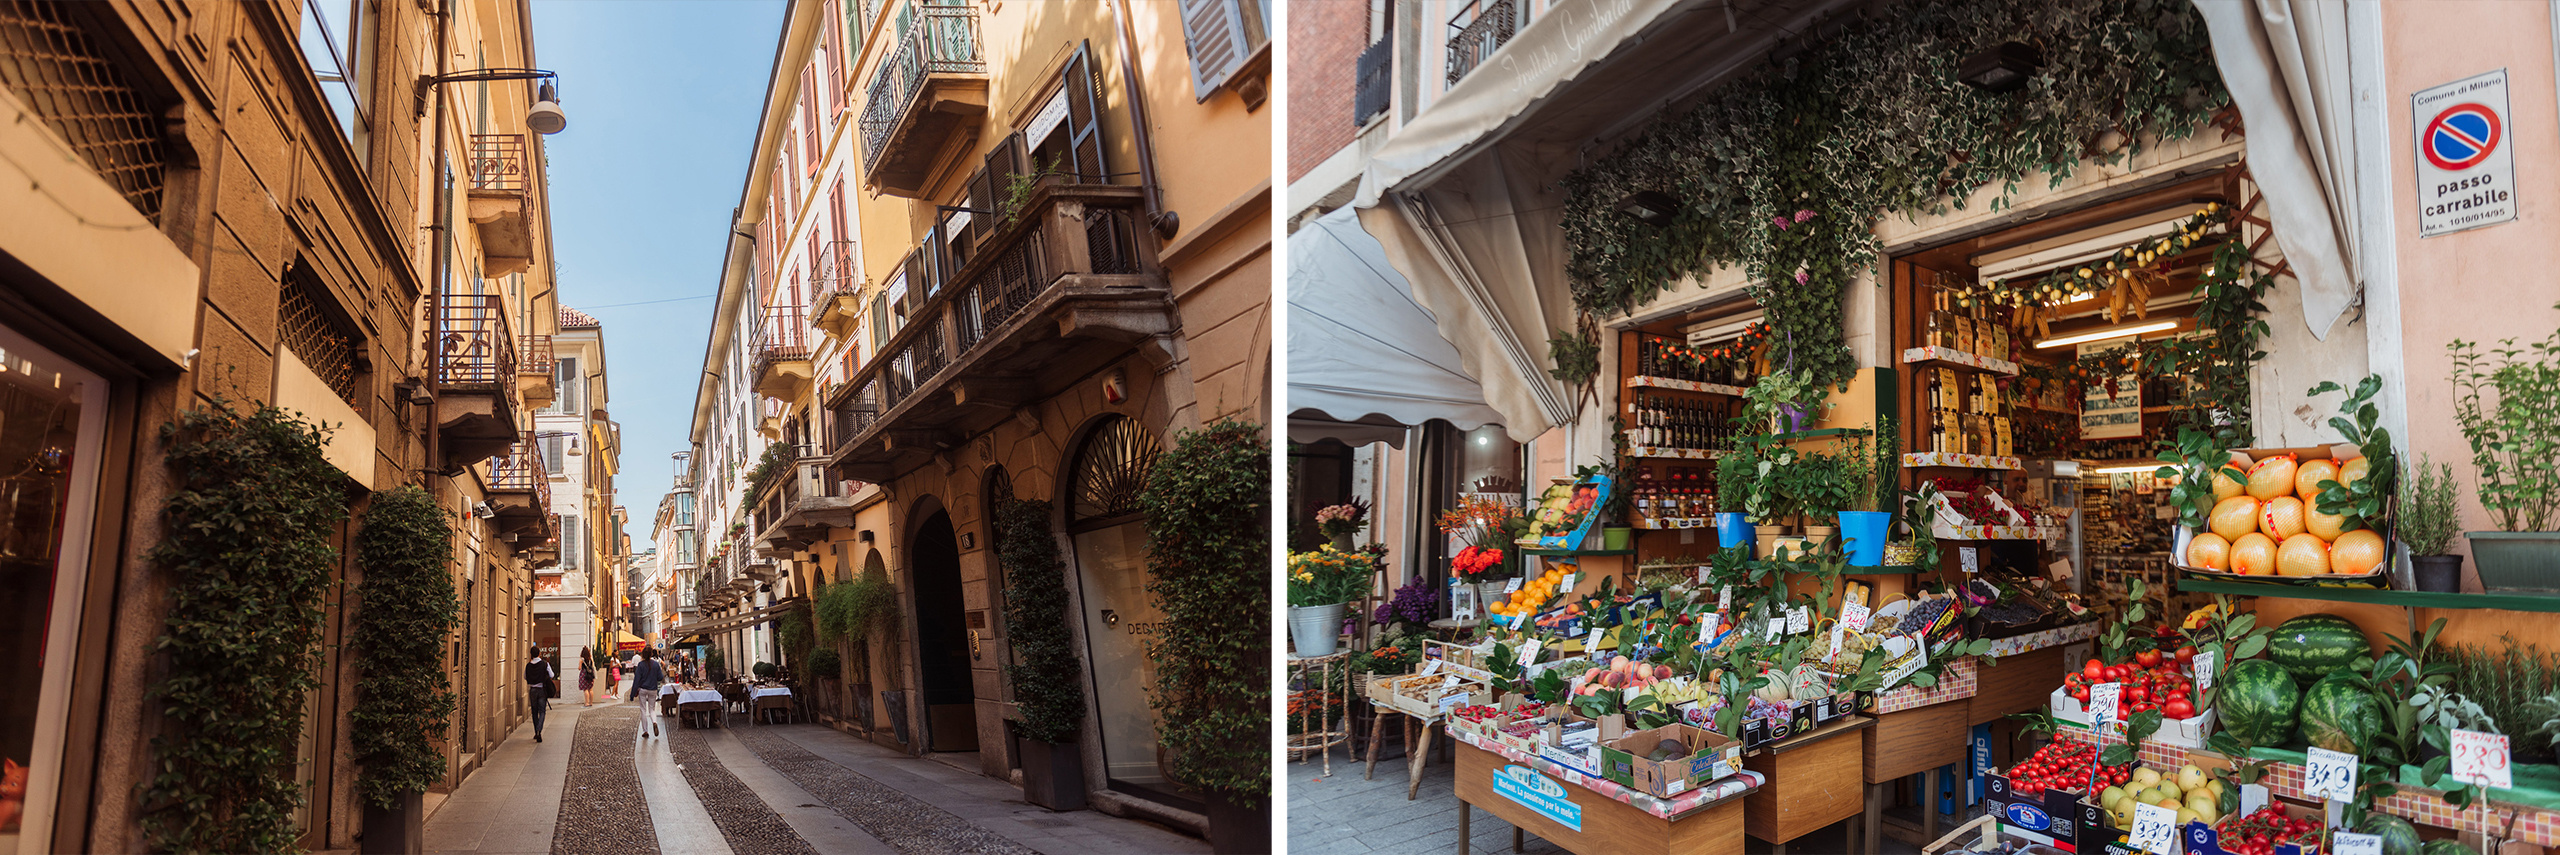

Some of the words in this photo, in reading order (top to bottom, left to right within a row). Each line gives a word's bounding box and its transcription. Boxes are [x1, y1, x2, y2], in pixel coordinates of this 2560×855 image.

[2418, 91, 2455, 105] Comune
[2458, 85, 2467, 95] di
[2469, 78, 2502, 92] Milano
[2437, 174, 2492, 198] passo
[2425, 189, 2508, 217] carrabile
[2449, 208, 2505, 226] 1010/014/95
[1544, 746, 1571, 765] Trentino
